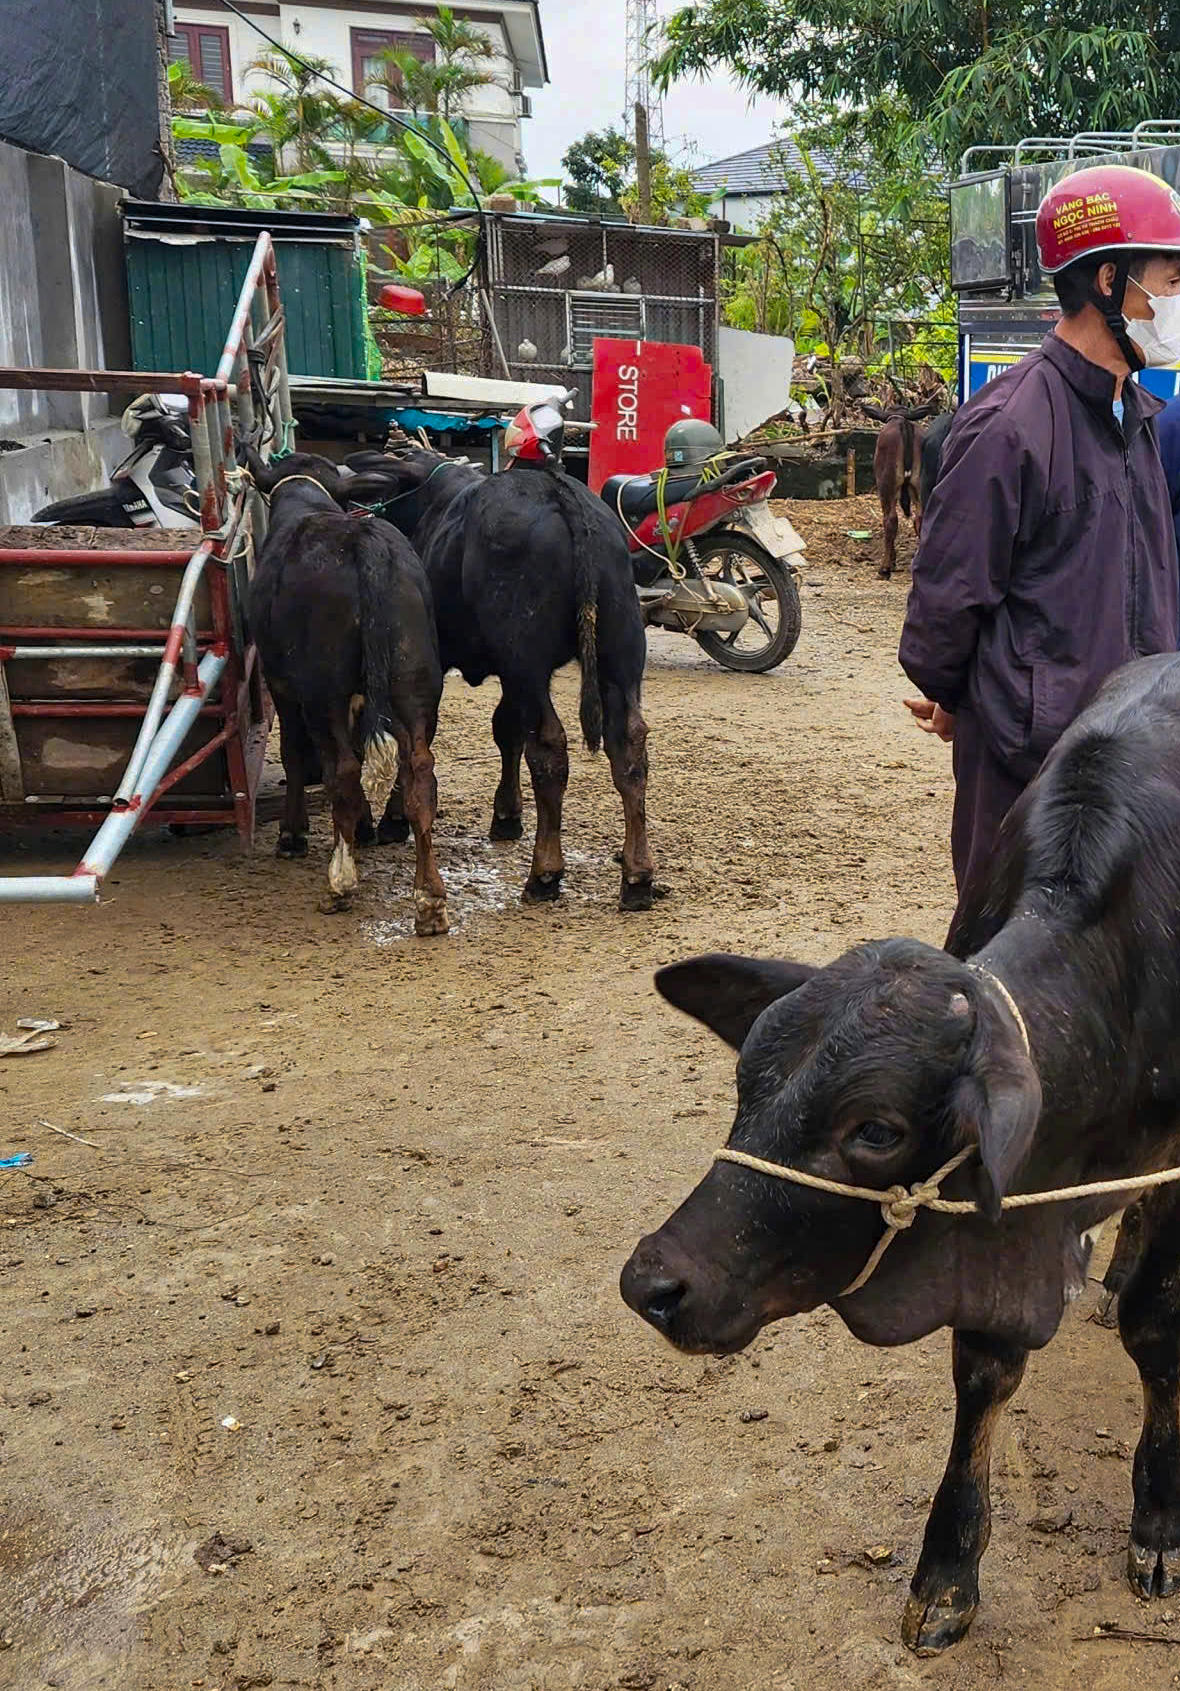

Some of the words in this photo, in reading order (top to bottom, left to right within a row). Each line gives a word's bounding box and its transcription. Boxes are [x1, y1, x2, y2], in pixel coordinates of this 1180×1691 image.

[1053, 209, 1084, 229] NGỌC
[1087, 201, 1117, 216] NINH
[617, 365, 638, 440] STORE
